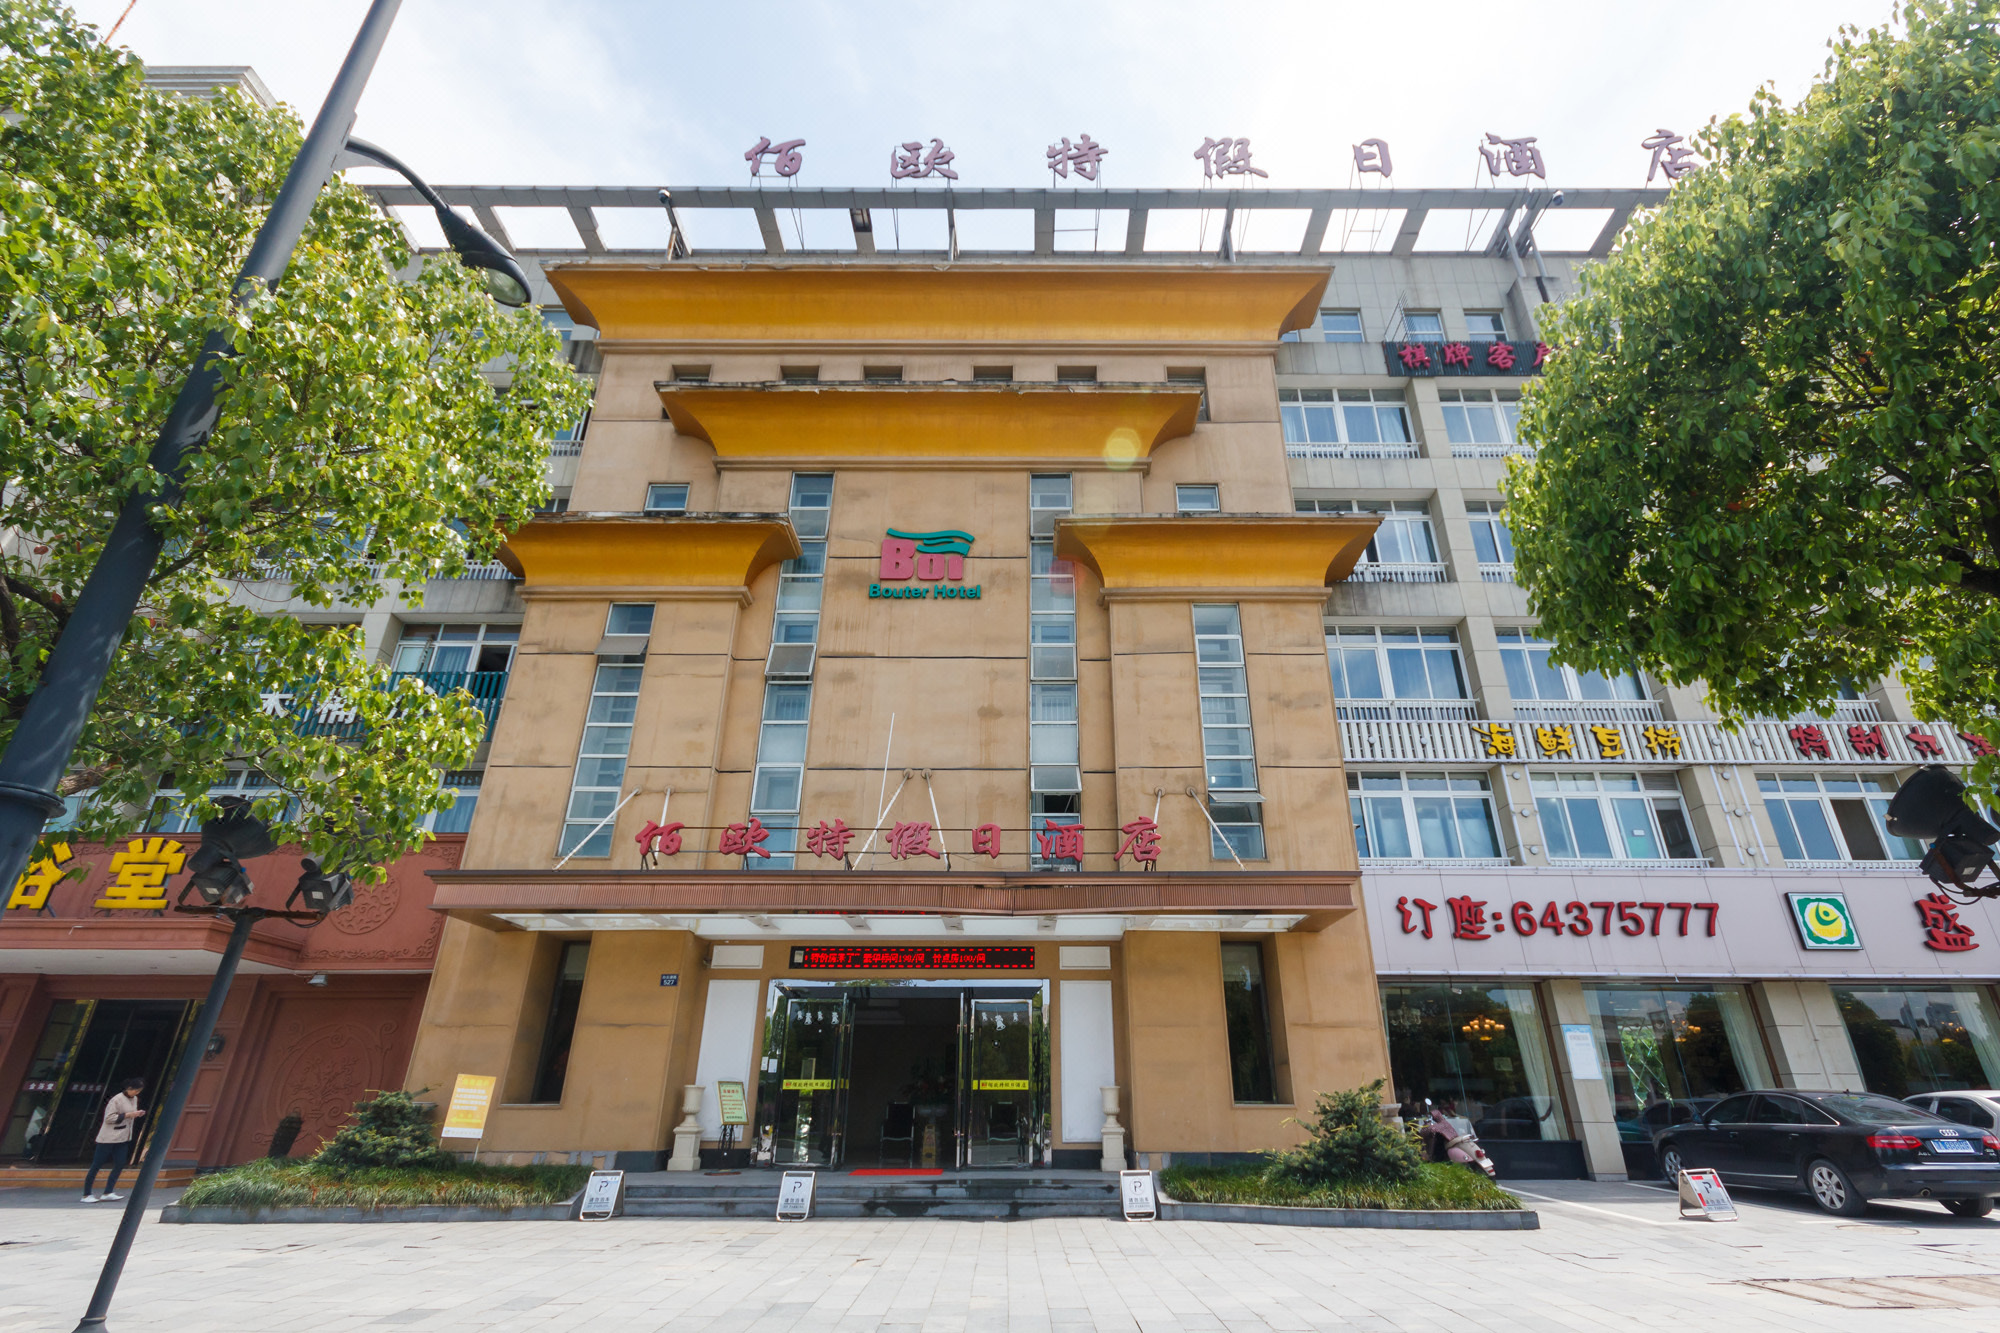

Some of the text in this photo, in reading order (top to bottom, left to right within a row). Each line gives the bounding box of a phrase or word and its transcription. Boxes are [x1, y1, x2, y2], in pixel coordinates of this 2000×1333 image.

[744, 129, 1699, 181] 佰欧特假日酒店
[868, 583, 981, 599] Bouter Hotel
[634, 816, 1163, 862] 佰欧特假日酒店
